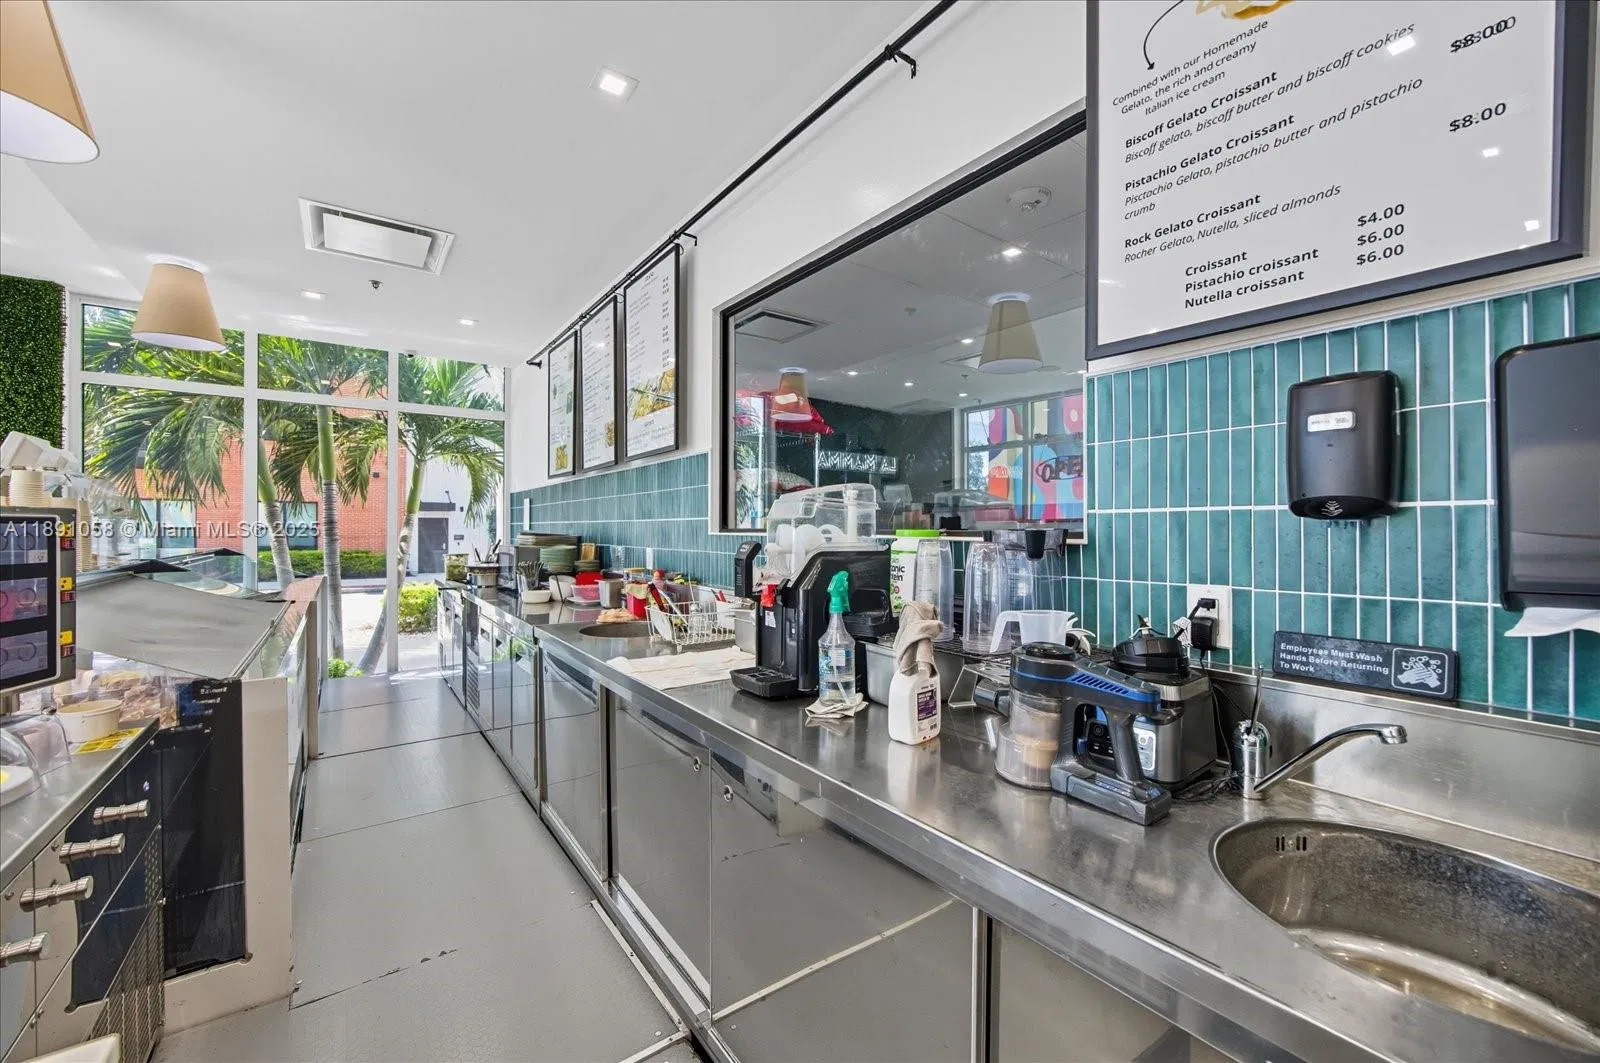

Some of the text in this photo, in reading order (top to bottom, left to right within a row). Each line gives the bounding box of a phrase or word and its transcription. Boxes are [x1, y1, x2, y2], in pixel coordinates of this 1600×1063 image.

[1112, 20, 1268, 106] Combined with our Homemade
[1125, 23, 1415, 163] Biscoff gelato, biscoff butter and biscoff cookies
[1145, 70, 1226, 116] Italian ice cream
[1155, 86, 1170, 98] the
[1173, 73, 1191, 89] rich
[1194, 61, 1214, 78] and
[1215, 41, 1257, 67] creamy
[1124, 78, 1423, 206] Pisctachio Gelato, pistachio butter and pistachio
[1125, 71, 1278, 148] Biscoff Gelato Croissant
[1449, 102, 1507, 132] $8.00
[1125, 115, 1295, 191] Pistachio Gelato Croissant
[1124, 202, 1156, 220] crumb
[1124, 184, 1341, 263] Rocher Gelato, Nutella, sliced almonds
[1125, 194, 1261, 248] Rock Gelato Croissant
[1185, 203, 1405, 277] Croissant $4.00
[1185, 223, 1405, 293] Pistachio croissant $6.00
[1185, 244, 1404, 309] Nutella croissant $6.00
[1280, 652, 1389, 675] Hands Before Returning
[1281, 643, 1383, 662] Employees Must Wash
[1291, 663, 1315, 672] Work
